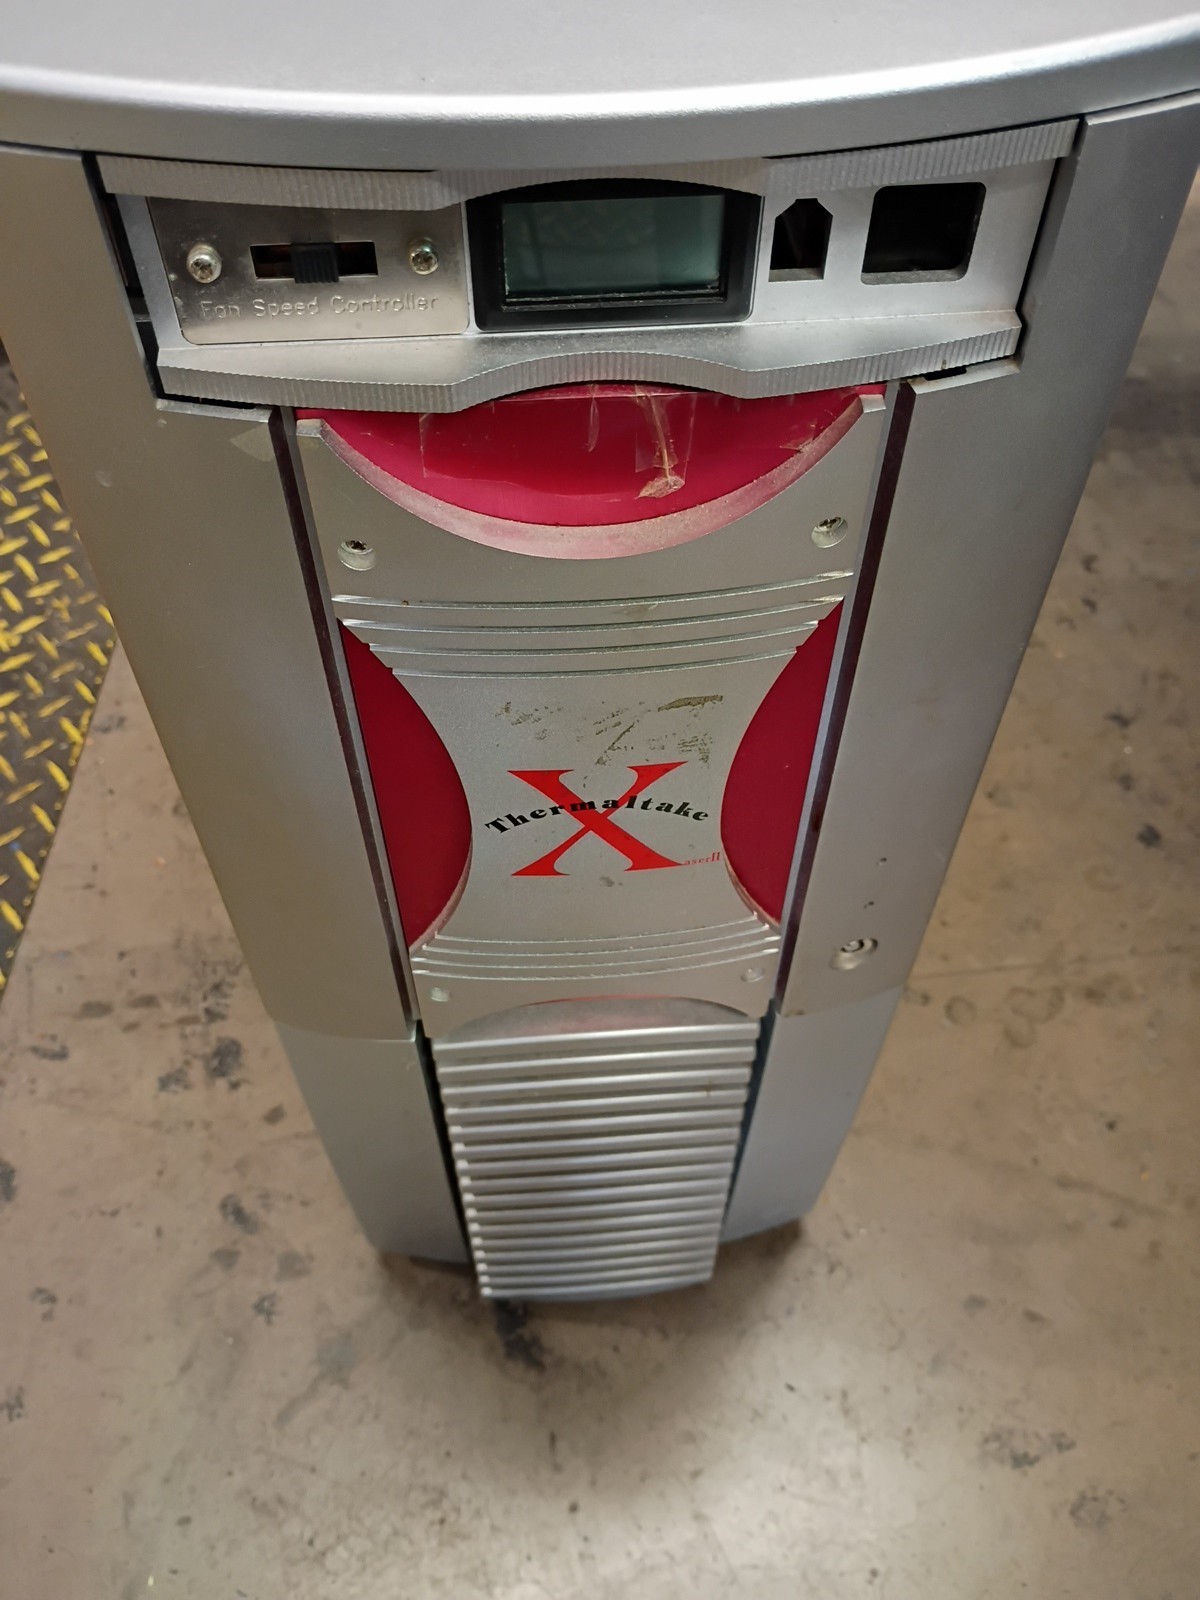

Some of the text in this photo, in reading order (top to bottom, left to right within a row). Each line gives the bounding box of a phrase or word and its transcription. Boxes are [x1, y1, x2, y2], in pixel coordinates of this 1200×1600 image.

[201, 293, 439, 319] Fan Speed Controller
[485, 795, 709, 834] Thermaltake
